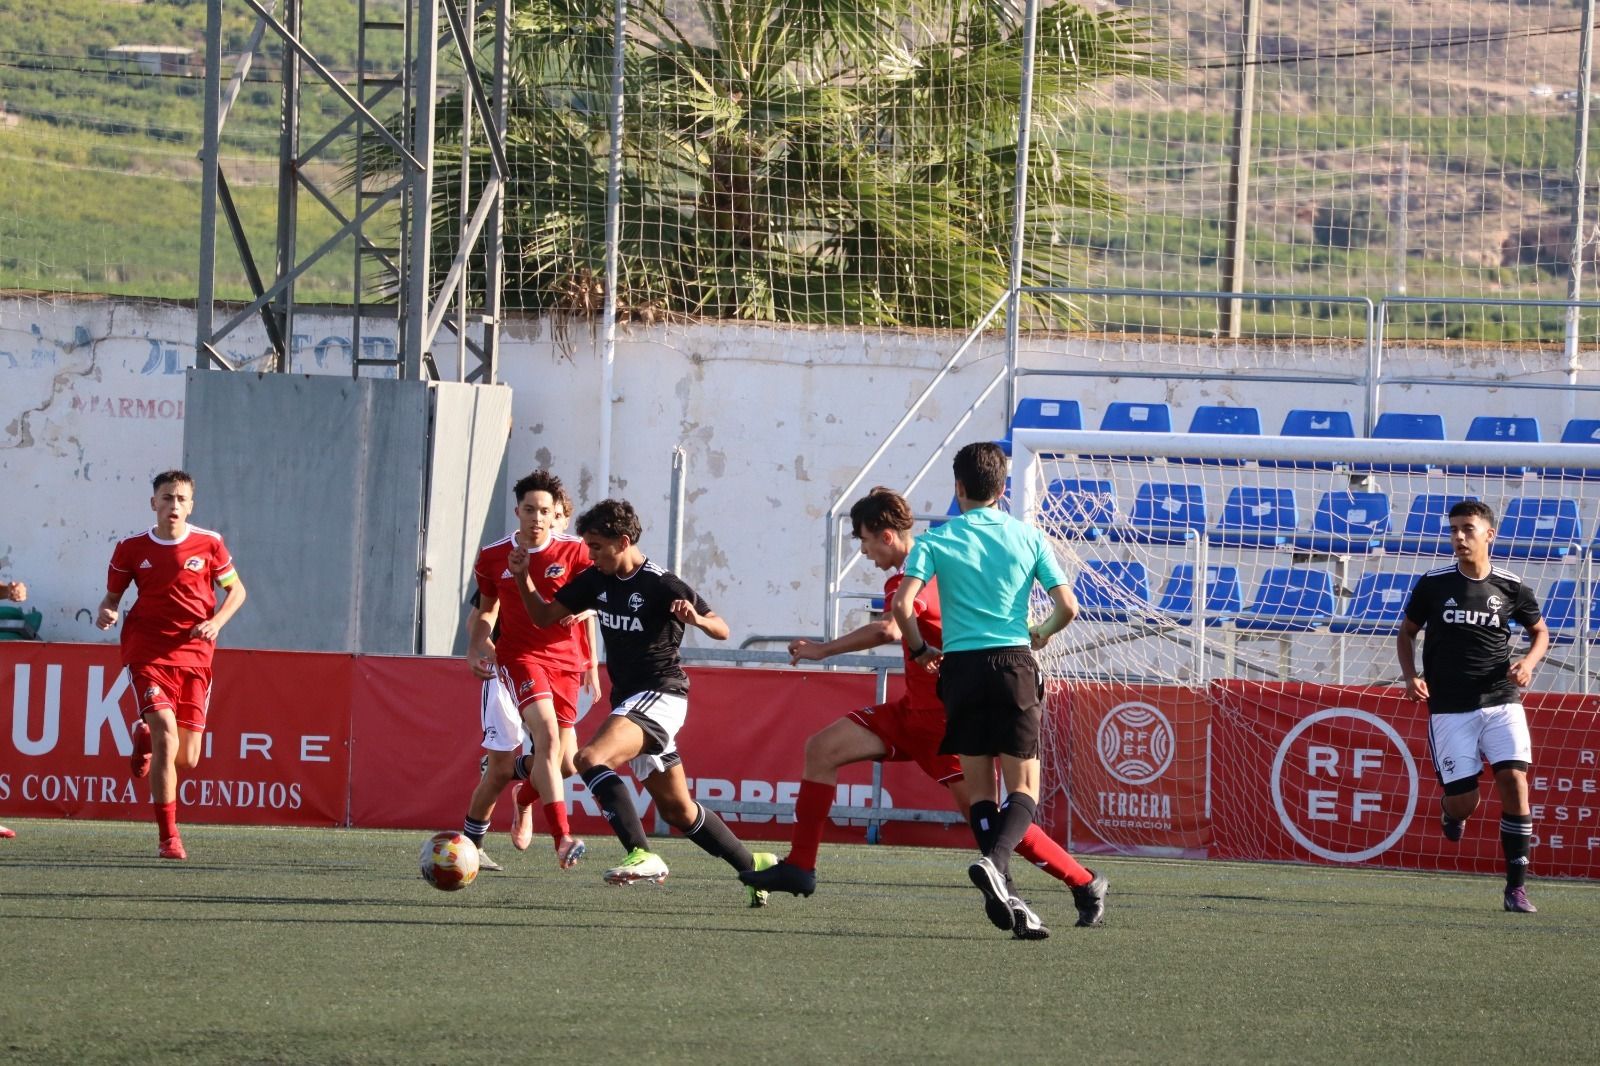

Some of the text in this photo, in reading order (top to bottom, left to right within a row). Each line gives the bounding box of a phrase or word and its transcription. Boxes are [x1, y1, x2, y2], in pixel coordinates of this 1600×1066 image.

[1443, 609, 1501, 628] CEUTA
[206, 732, 331, 762] IRE
[22, 774, 139, 804] CONTRA
[148, 779, 302, 810] CENDIOS
[1098, 791, 1172, 819] TERCERA
[1097, 818, 1172, 830] FEDERACIÓN
